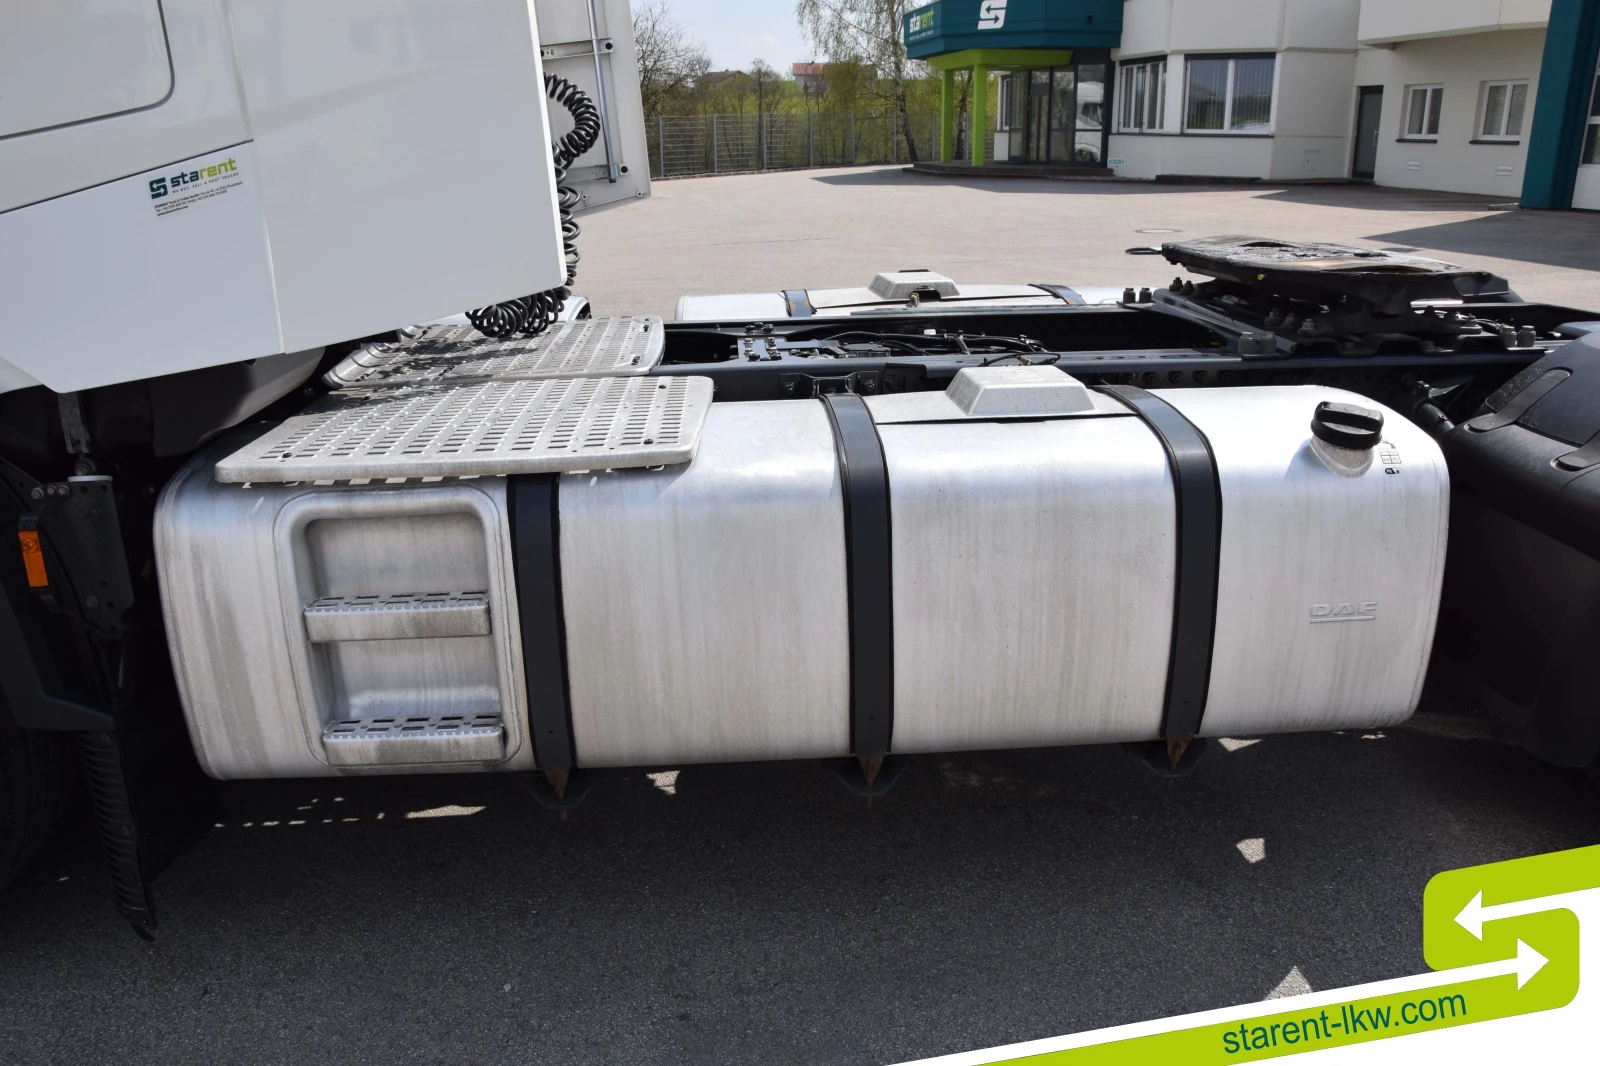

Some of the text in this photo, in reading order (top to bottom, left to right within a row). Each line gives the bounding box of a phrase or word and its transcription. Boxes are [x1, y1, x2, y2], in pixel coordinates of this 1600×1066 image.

[909, 7, 934, 33] starent
[170, 158, 237, 188] starent
[1310, 601, 1377, 617] DAF
